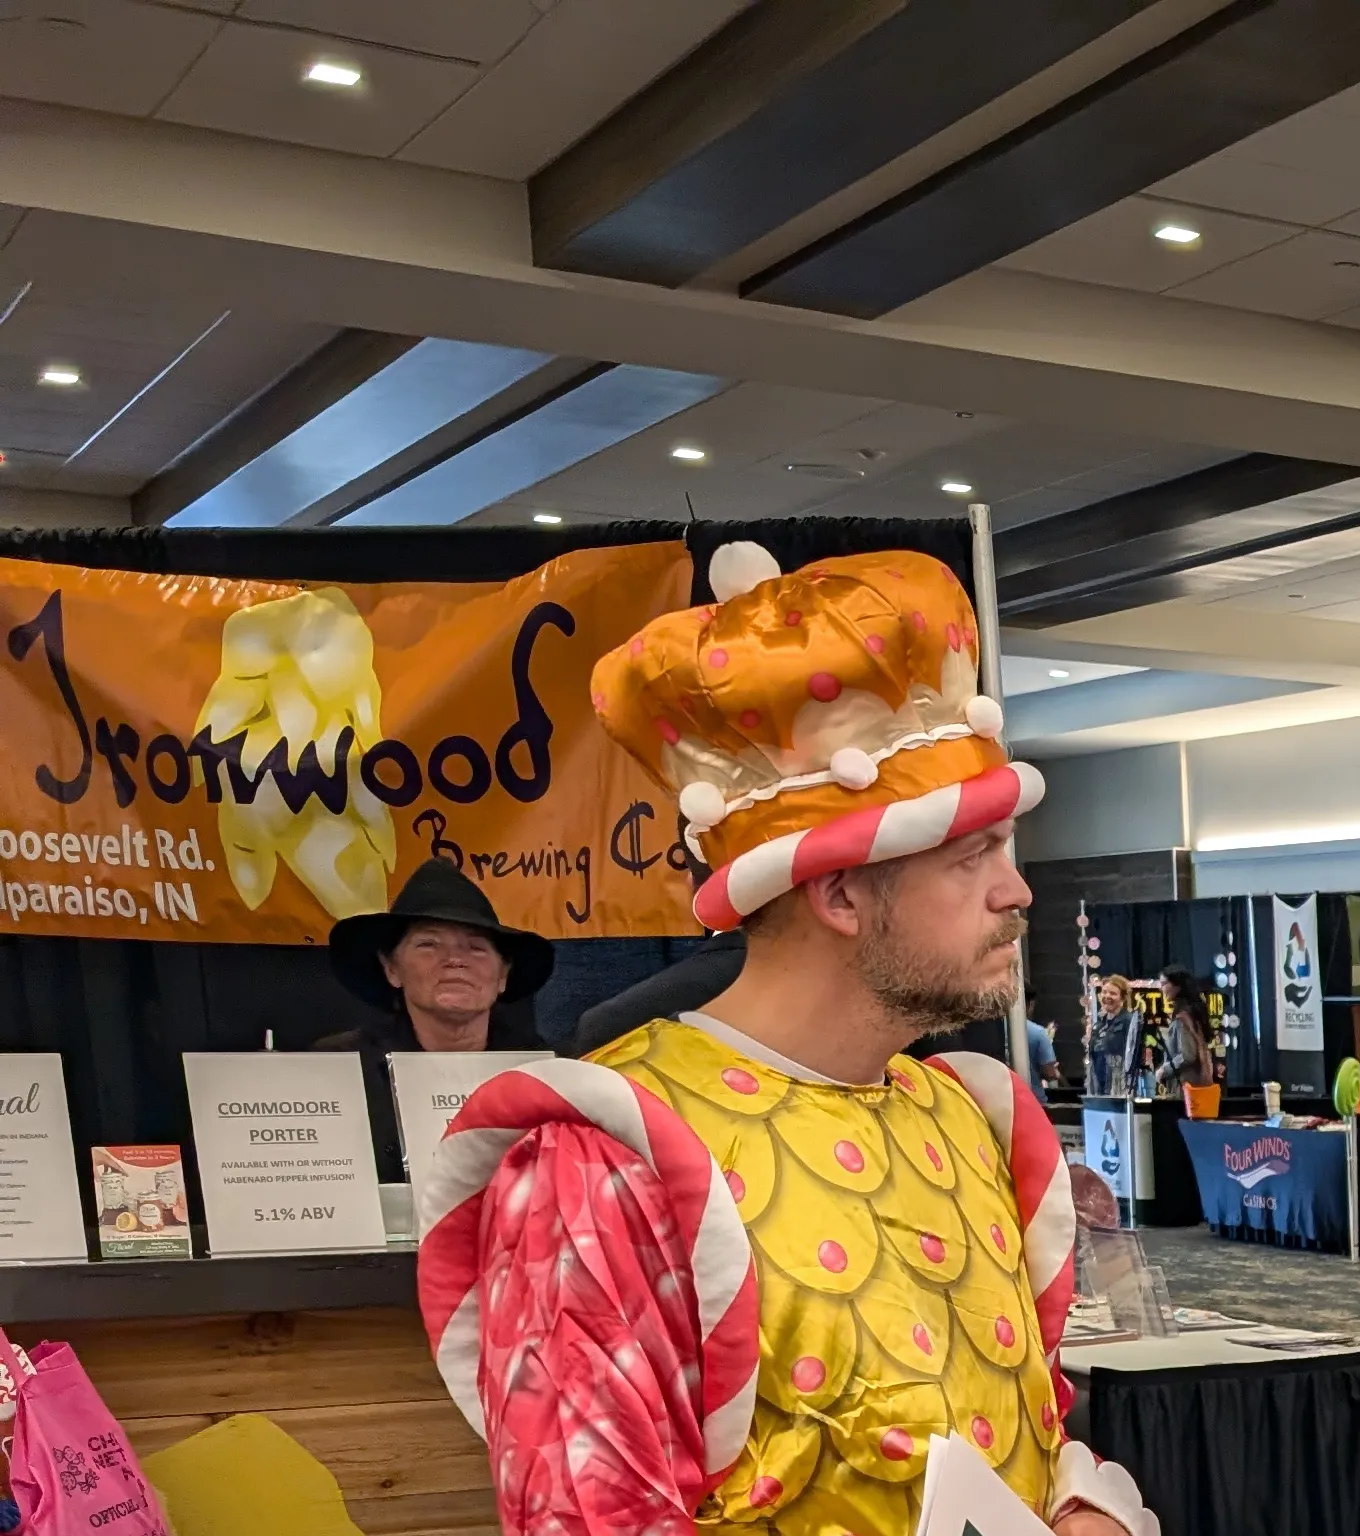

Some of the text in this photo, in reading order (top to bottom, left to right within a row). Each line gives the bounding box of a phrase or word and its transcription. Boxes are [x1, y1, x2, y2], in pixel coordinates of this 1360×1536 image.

[8, 588, 576, 815] Ironwood
[155, 828, 215, 872] Rd.
[412, 808, 591, 924] Brewing
[154, 881, 199, 922] IN
[218, 1101, 342, 1117] COMMODORE
[249, 1128, 319, 1143] PORTER
[221, 1158, 354, 1169] AVAILABLE WITH OR WITHOUT
[1223, 1137, 1290, 1172] FOUR WINDS
[275, 1174, 309, 1183] PEPPER
[254, 1207, 336, 1222] 5.1% ABV
